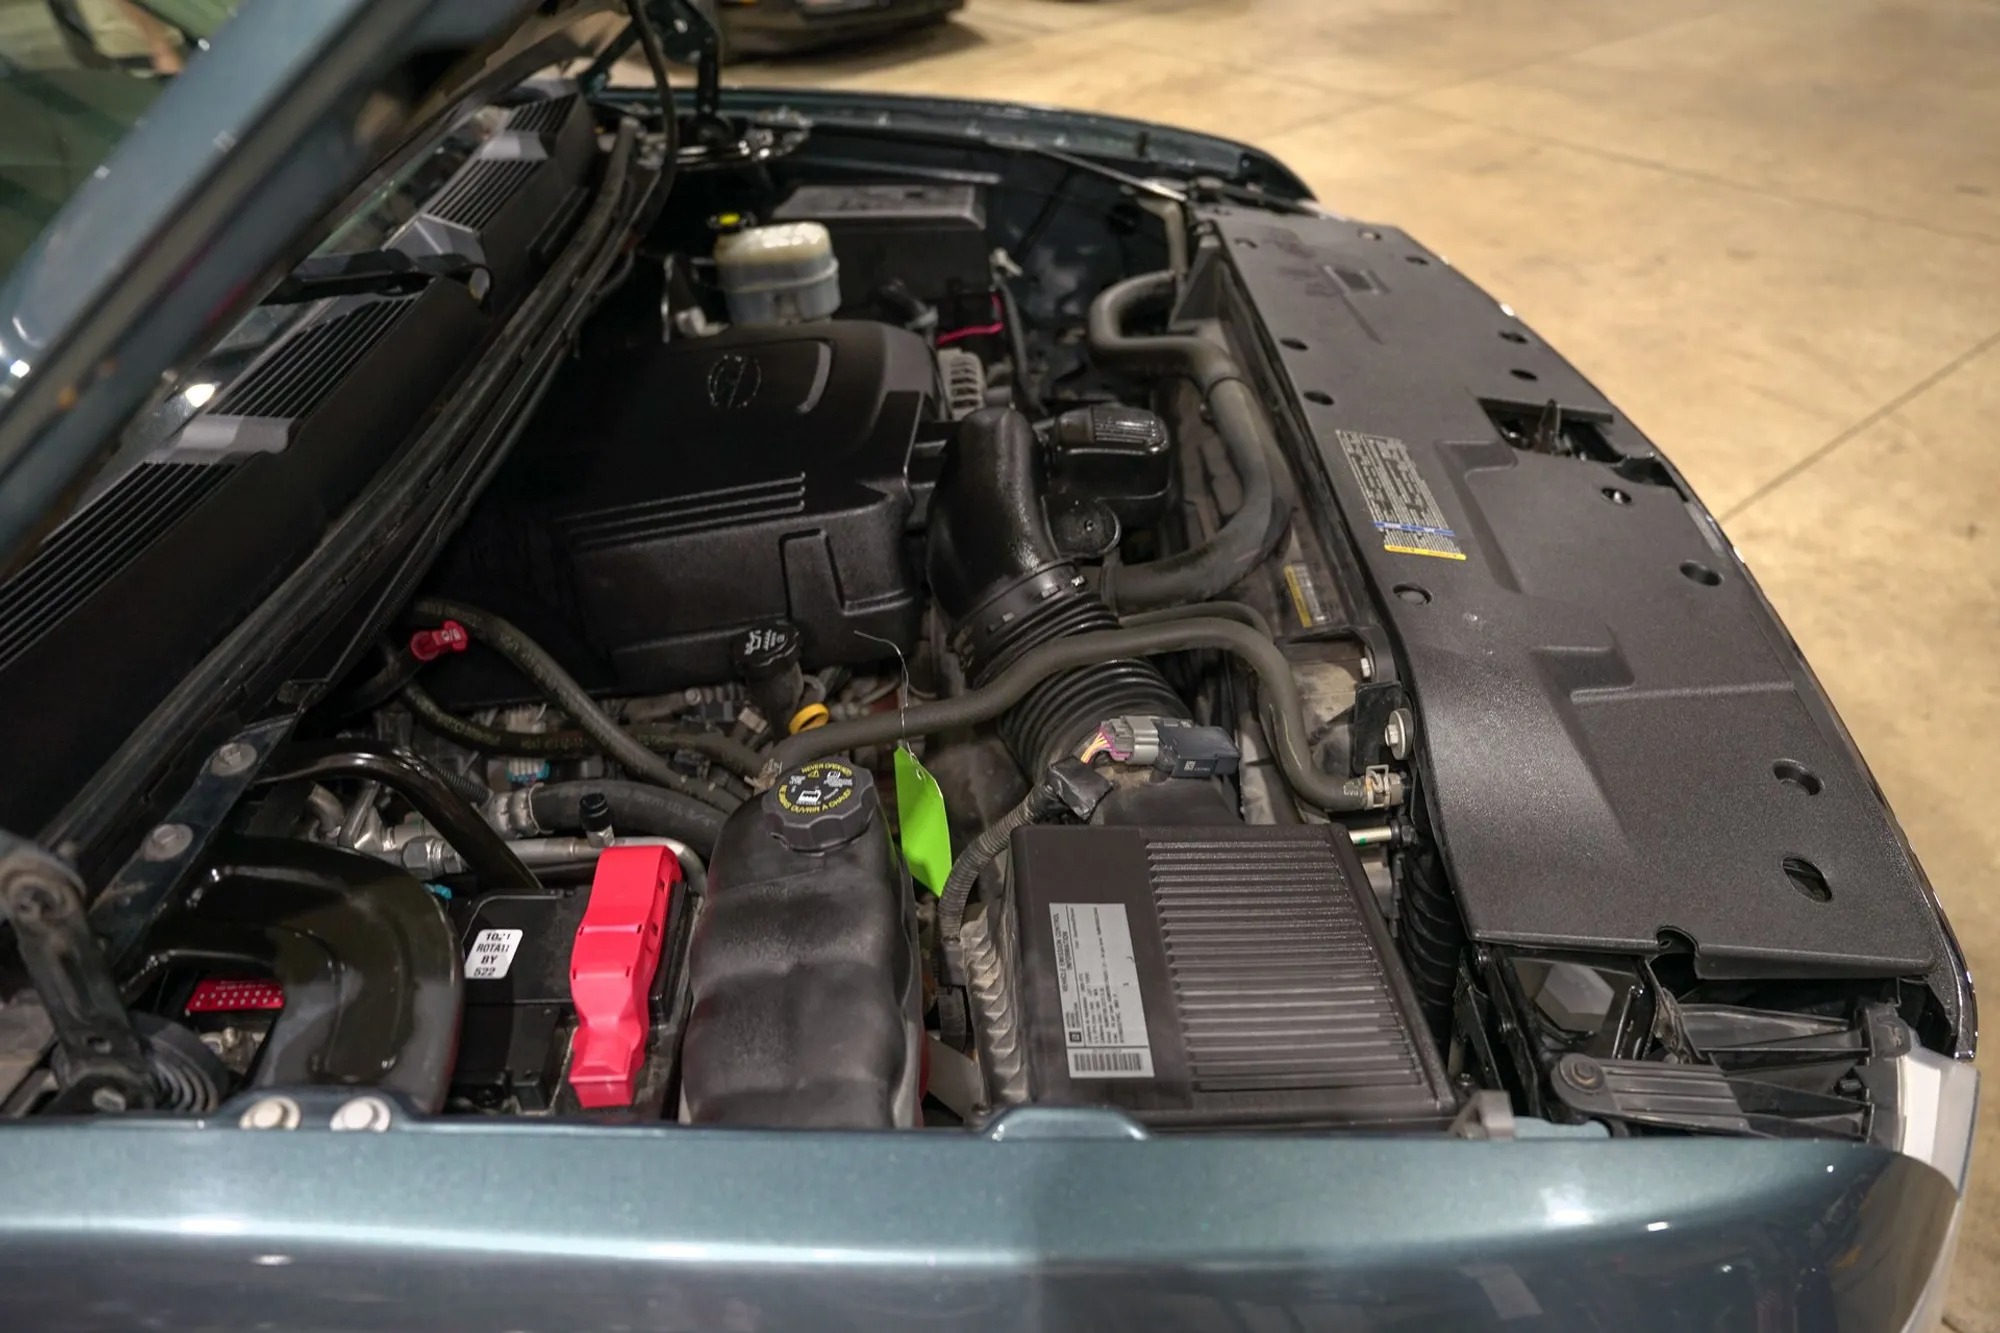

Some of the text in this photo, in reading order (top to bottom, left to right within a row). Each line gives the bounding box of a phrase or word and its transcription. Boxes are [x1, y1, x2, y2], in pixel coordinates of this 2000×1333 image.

[801, 763, 824, 773] NEVER
[791, 804, 820, 813] OUVRIR
[481, 955, 498, 965] BY
[474, 967, 496, 977] 522
